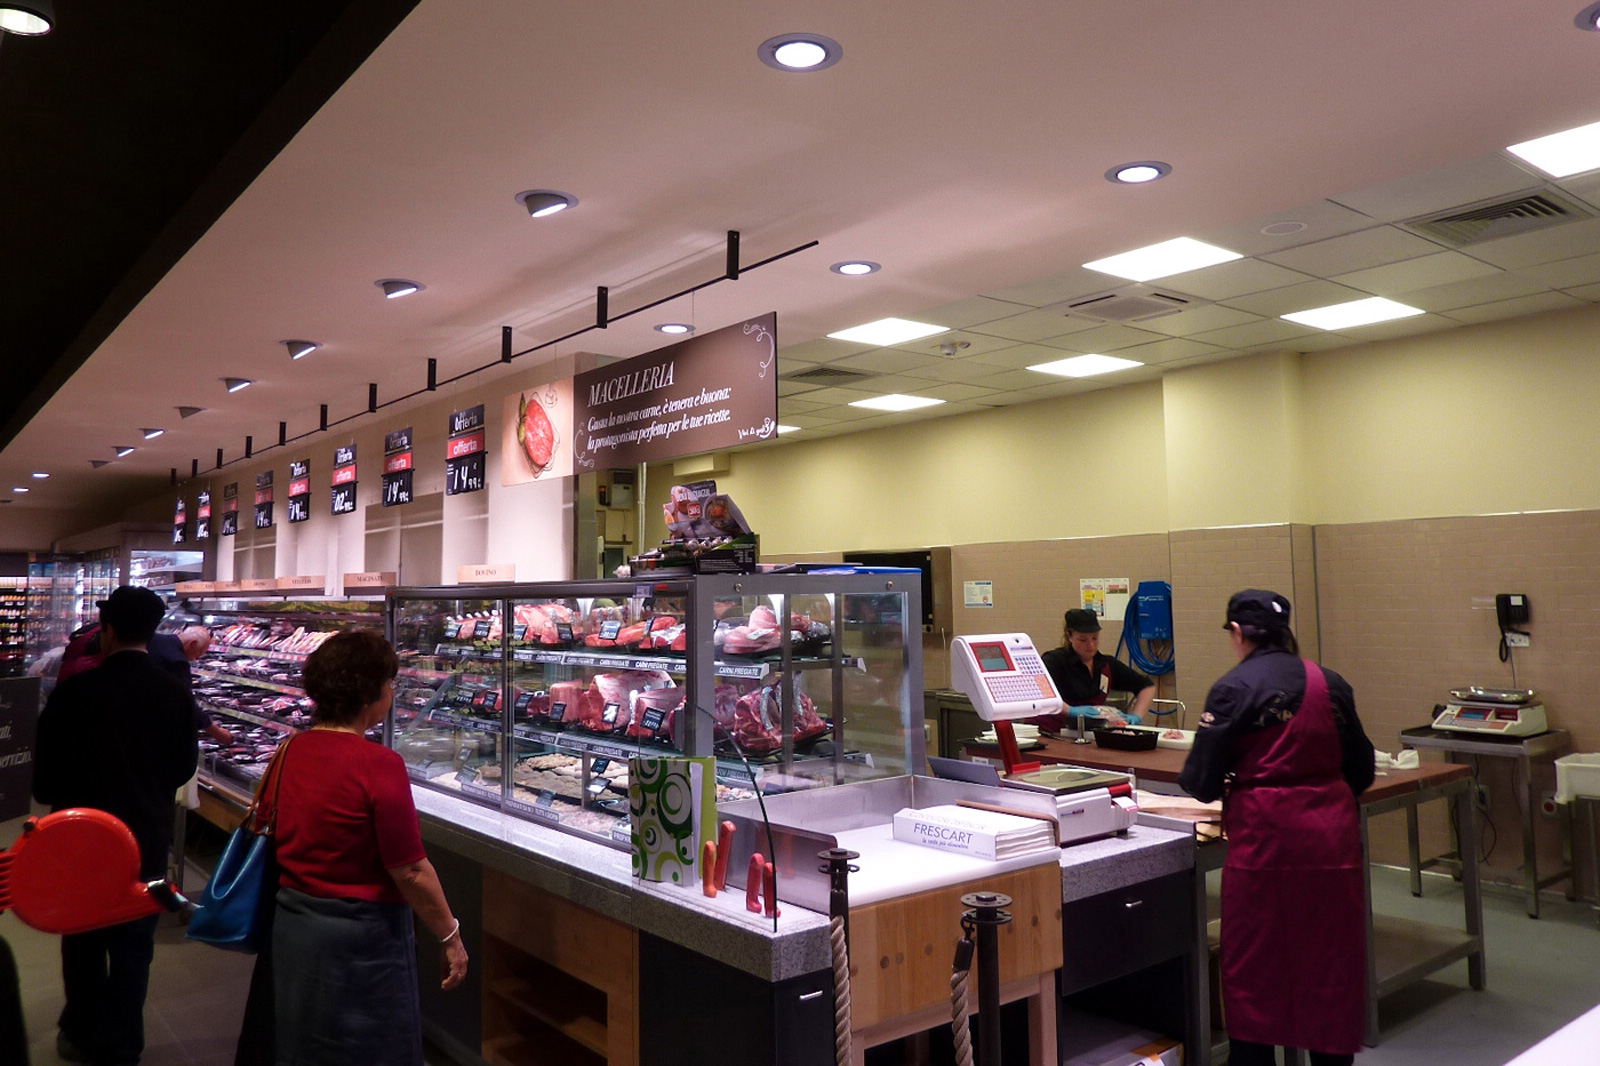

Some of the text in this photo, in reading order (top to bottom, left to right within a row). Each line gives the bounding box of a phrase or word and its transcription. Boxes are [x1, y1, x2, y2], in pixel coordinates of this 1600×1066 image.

[587, 361, 675, 408] MACELLERIA
[608, 412, 616, 427] la
[616, 410, 640, 424] nostra
[640, 405, 662, 420] carne,
[668, 396, 694, 413] tenera
[700, 388, 732, 405] buona:
[453, 440, 478, 455] offerta
[587, 409, 731, 454] la protagonista perfetta per le tue ricette.
[913, 823, 973, 844] FRESCART
